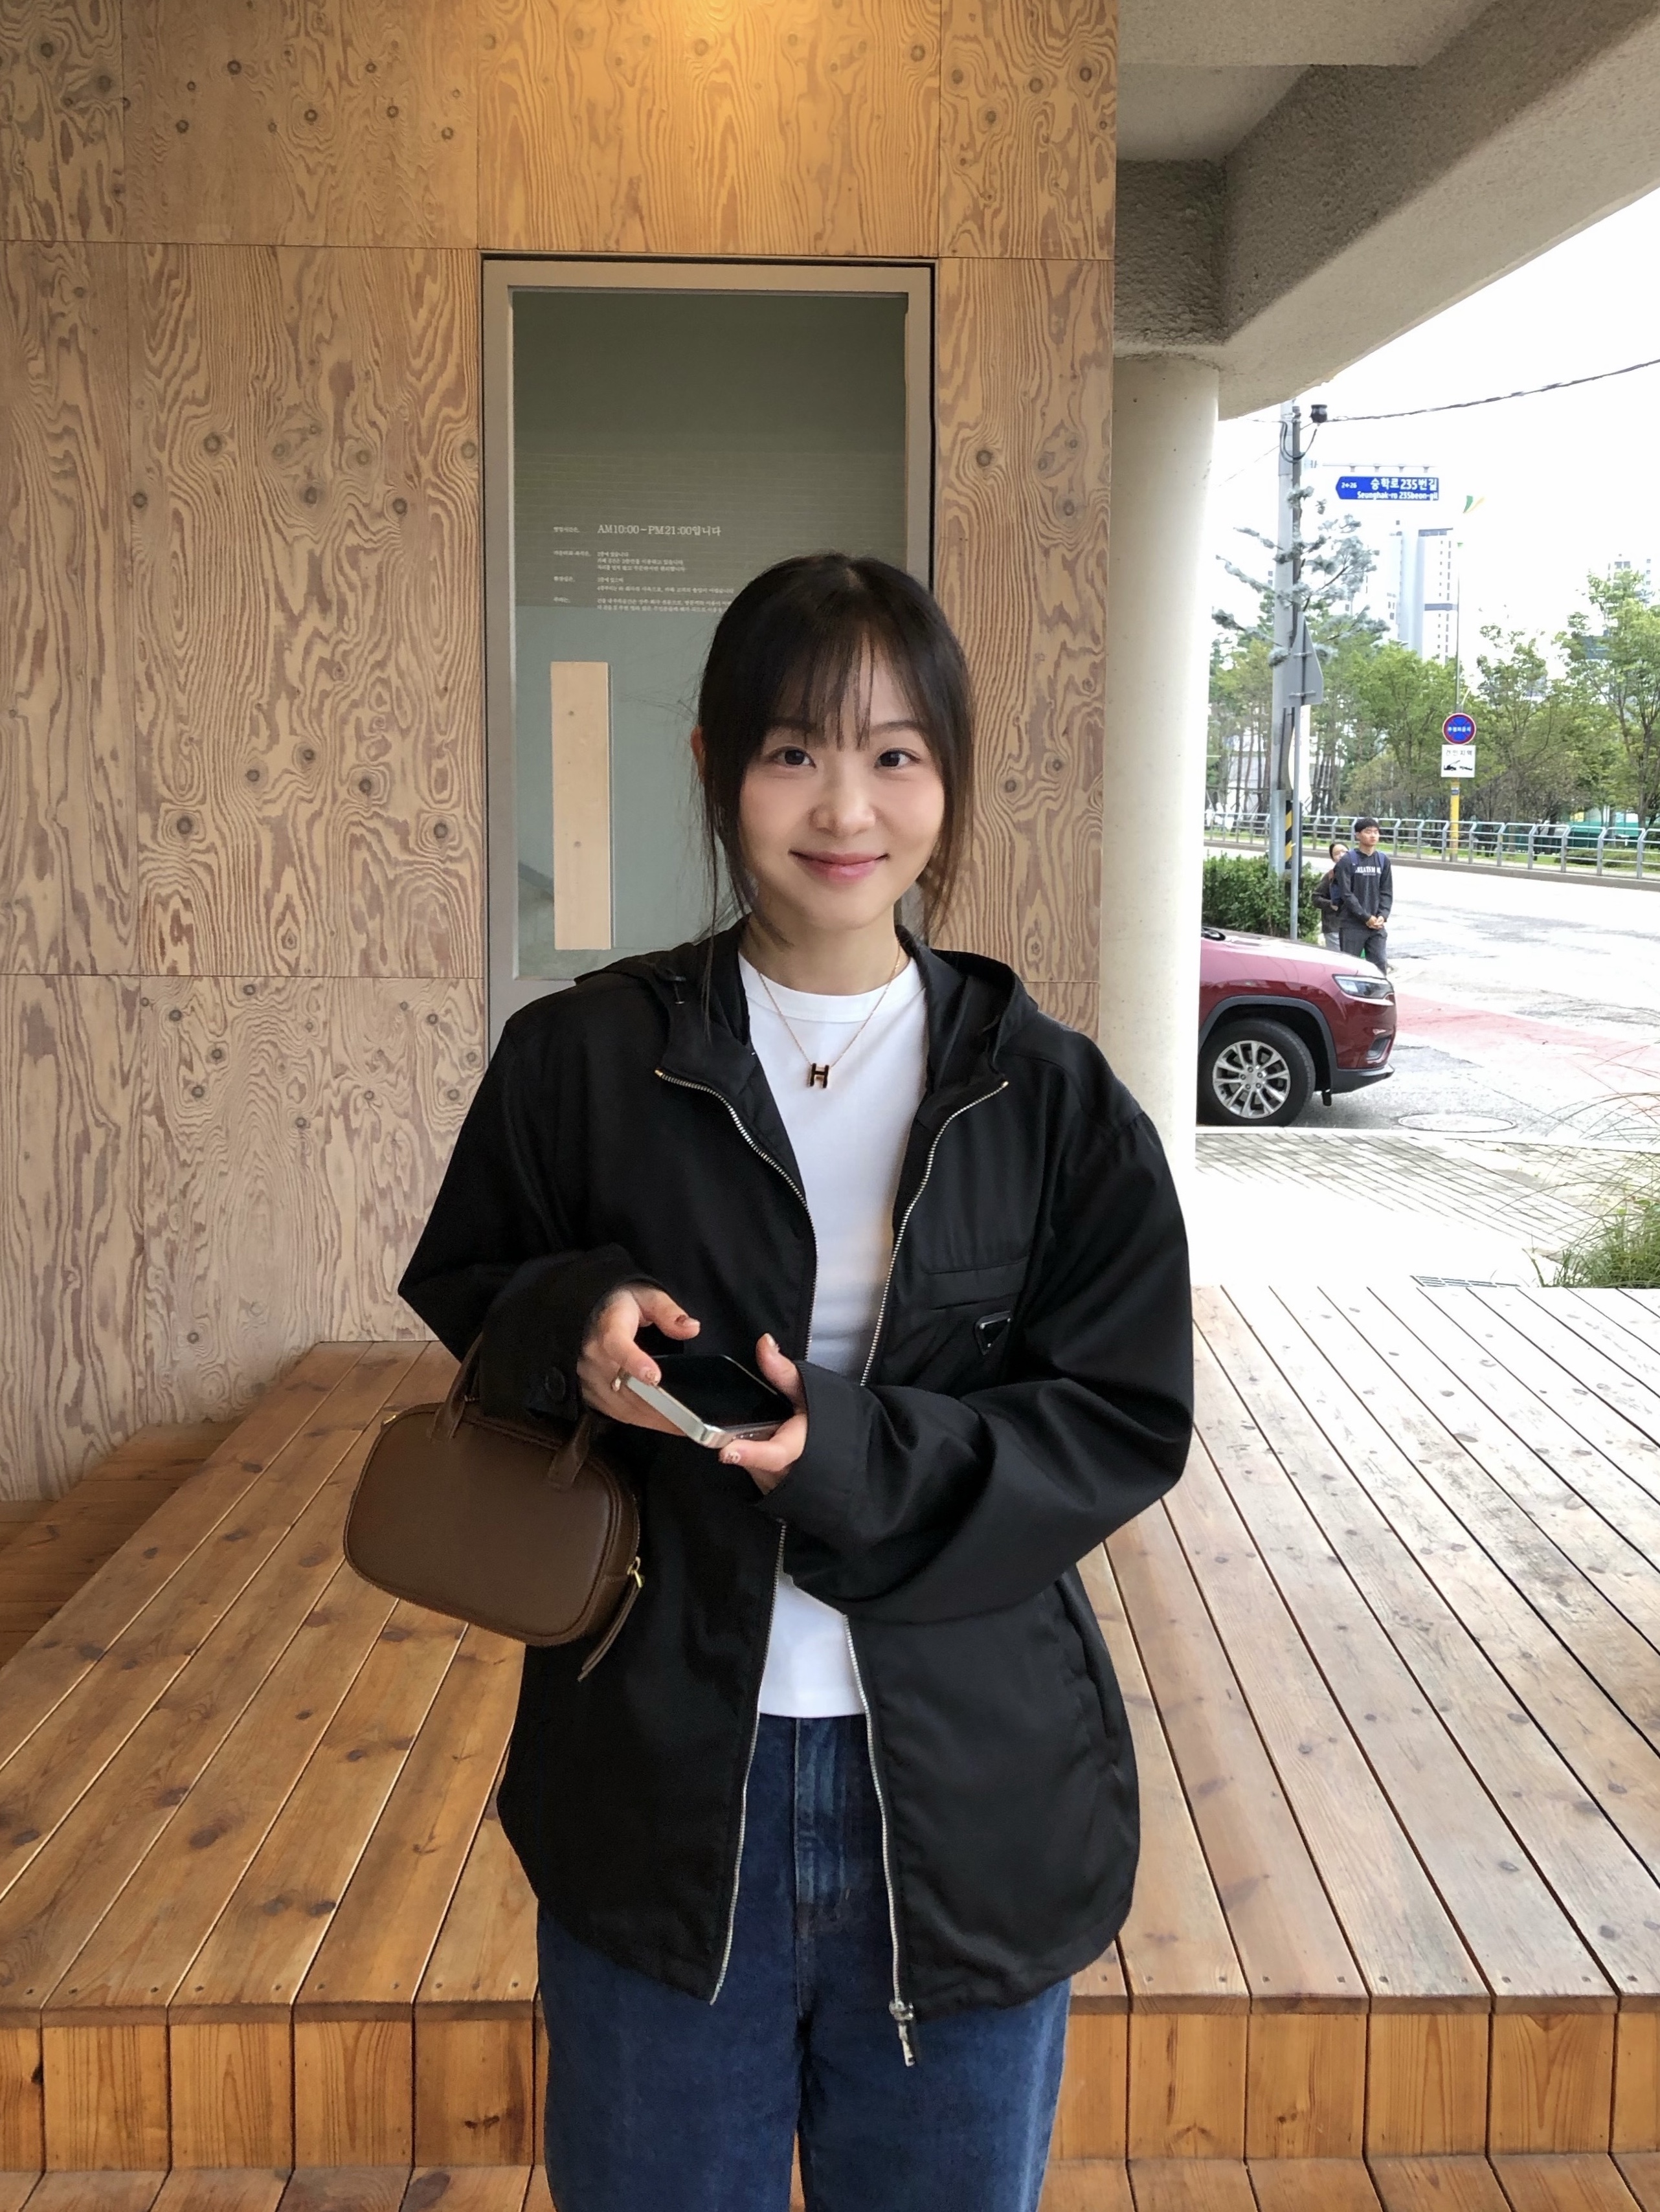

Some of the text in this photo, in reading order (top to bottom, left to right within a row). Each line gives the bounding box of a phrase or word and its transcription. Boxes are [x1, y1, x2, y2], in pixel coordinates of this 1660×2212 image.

[1371, 478, 1437, 491] 승학로235번길
[1357, 491, 1438, 501] Seunghak-ro 235beon-gil
[809, 1063, 829, 1088] H
